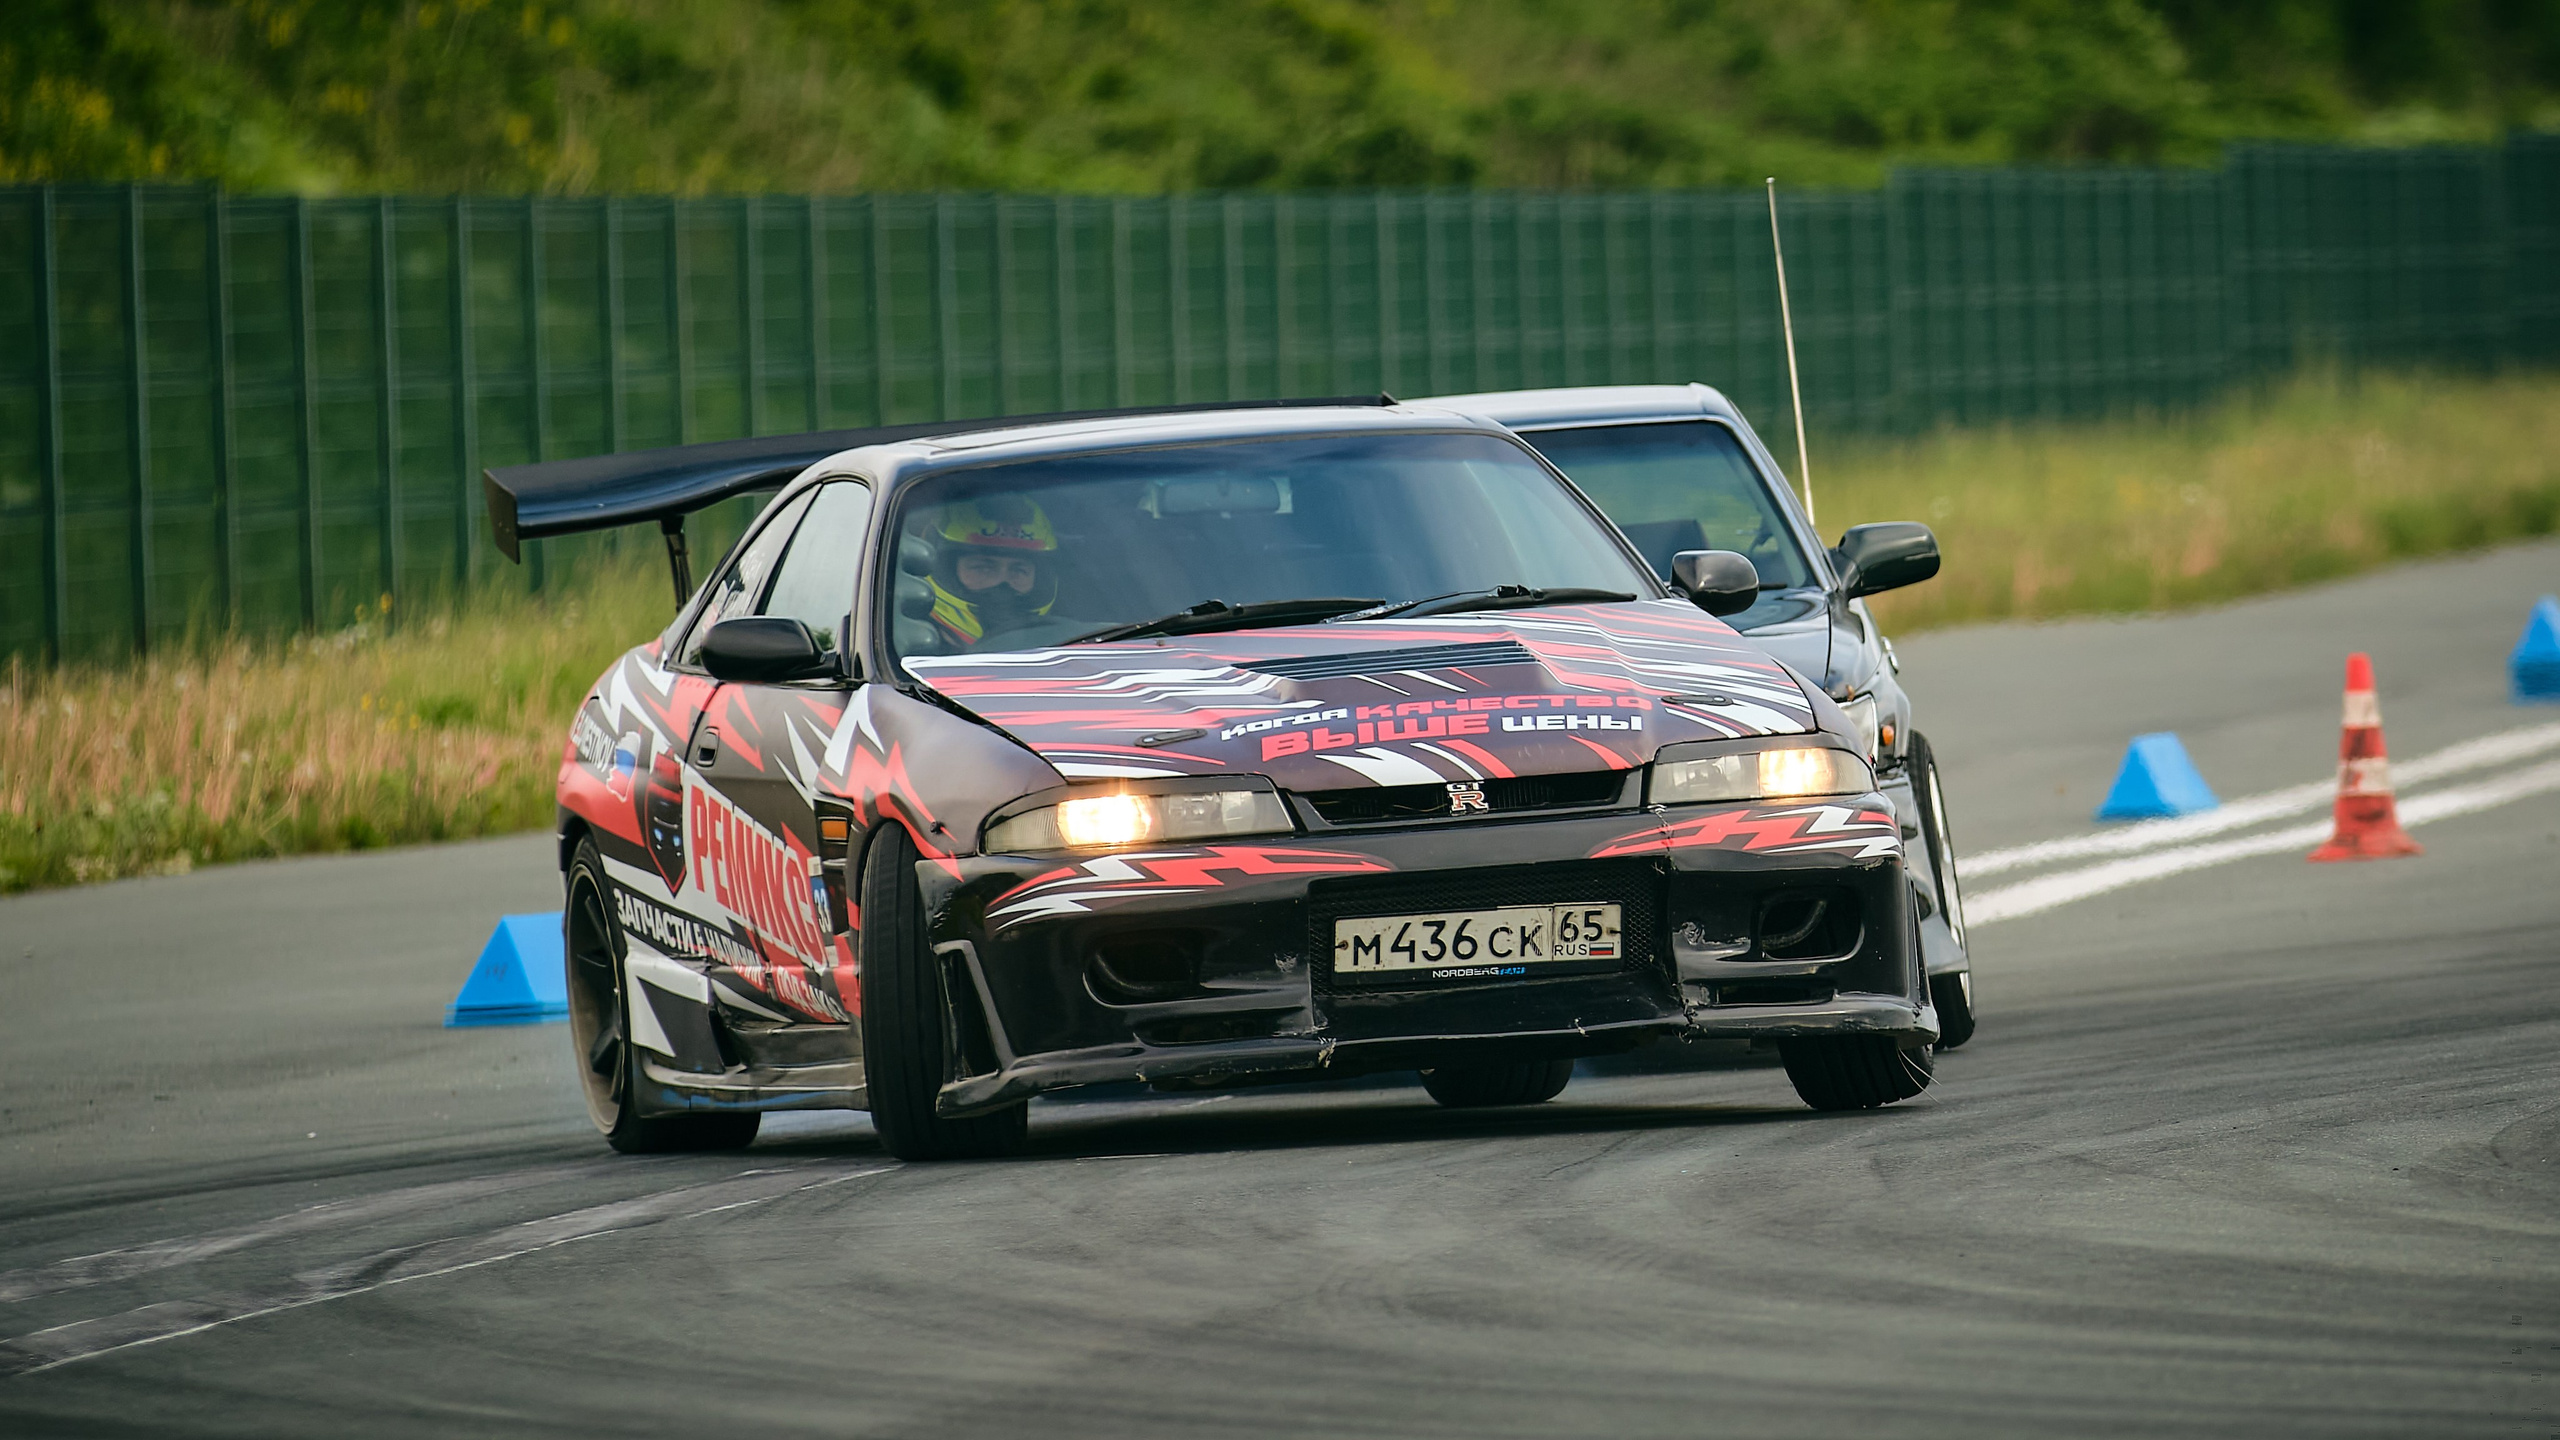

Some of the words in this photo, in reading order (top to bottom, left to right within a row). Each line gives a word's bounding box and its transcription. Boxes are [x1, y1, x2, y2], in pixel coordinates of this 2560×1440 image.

[1220, 707, 1348, 741] КОГДА
[1355, 694, 1652, 720] КАЧЕСТВО
[1261, 713, 1490, 762] ВЫШЕ
[1501, 714, 1643, 732] ЦЕНЫ
[690, 784, 824, 966] РЕМИКС
[613, 887, 695, 954] ЗАПЧАСТИ
[1560, 909, 1604, 942] 65
[1554, 943, 1588, 957] RUS
